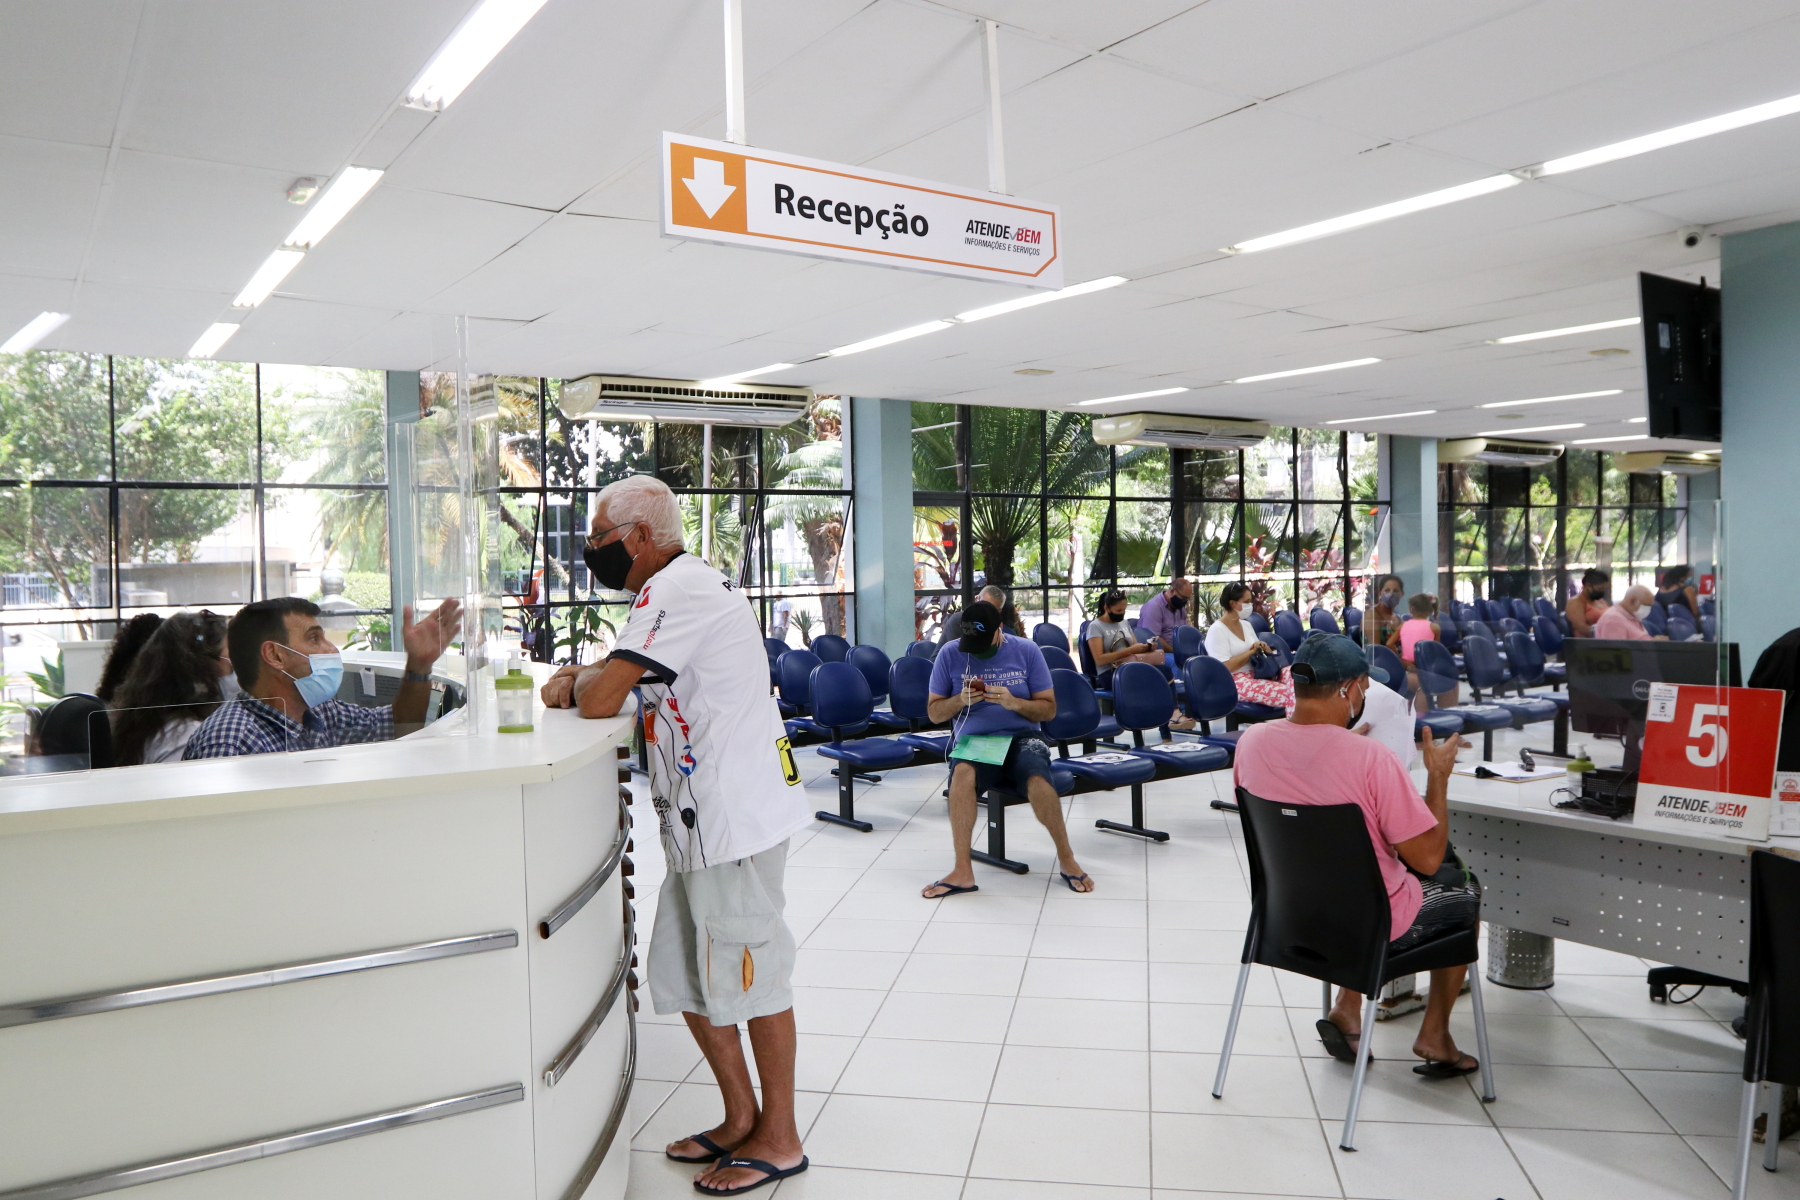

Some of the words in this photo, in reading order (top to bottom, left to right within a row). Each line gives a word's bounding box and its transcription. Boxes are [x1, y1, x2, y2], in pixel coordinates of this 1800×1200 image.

[775, 184, 929, 239] Recepção
[965, 219, 1011, 240] ATENDE
[1016, 227, 1041, 245] BEM
[964, 236, 1007, 251] INFORMAÇÕES
[1012, 244, 1040, 256] SERVIÇOS
[998, 669, 1027, 679] JOURNEY
[1685, 702, 1729, 768] 5
[1654, 810, 1701, 822] INFORMAÇÕES
[1702, 816, 1708, 824] E
[1657, 795, 1709, 813] ATENDE
[1715, 801, 1747, 818] BEM
